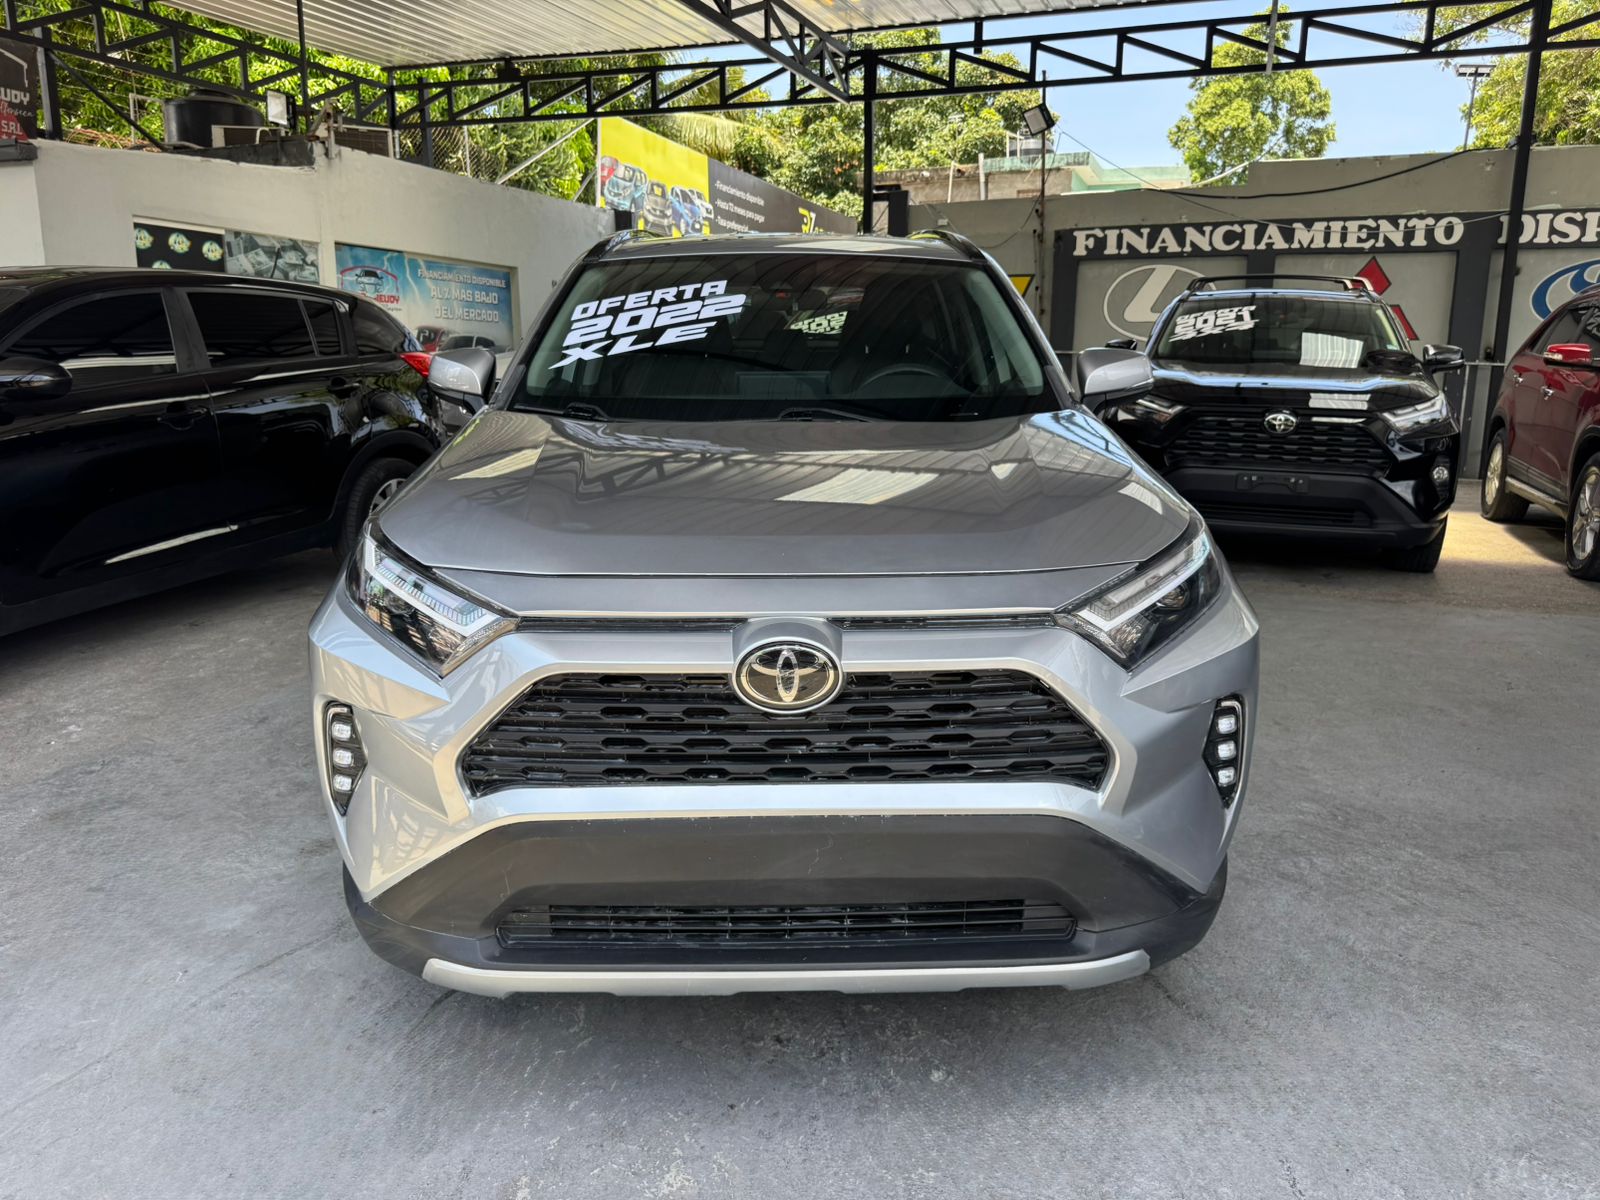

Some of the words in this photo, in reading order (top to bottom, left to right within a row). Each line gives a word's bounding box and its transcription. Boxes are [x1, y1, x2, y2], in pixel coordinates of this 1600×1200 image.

[1073, 216, 1464, 257] FINANCIAMIENTO
[455, 306, 500, 323] MERCADO
[474, 291, 499, 305] BAJO
[571, 279, 728, 321] OFERTA
[562, 294, 747, 348] 2022
[1174, 309, 1253, 335] 2021
[548, 321, 718, 370] XLE
